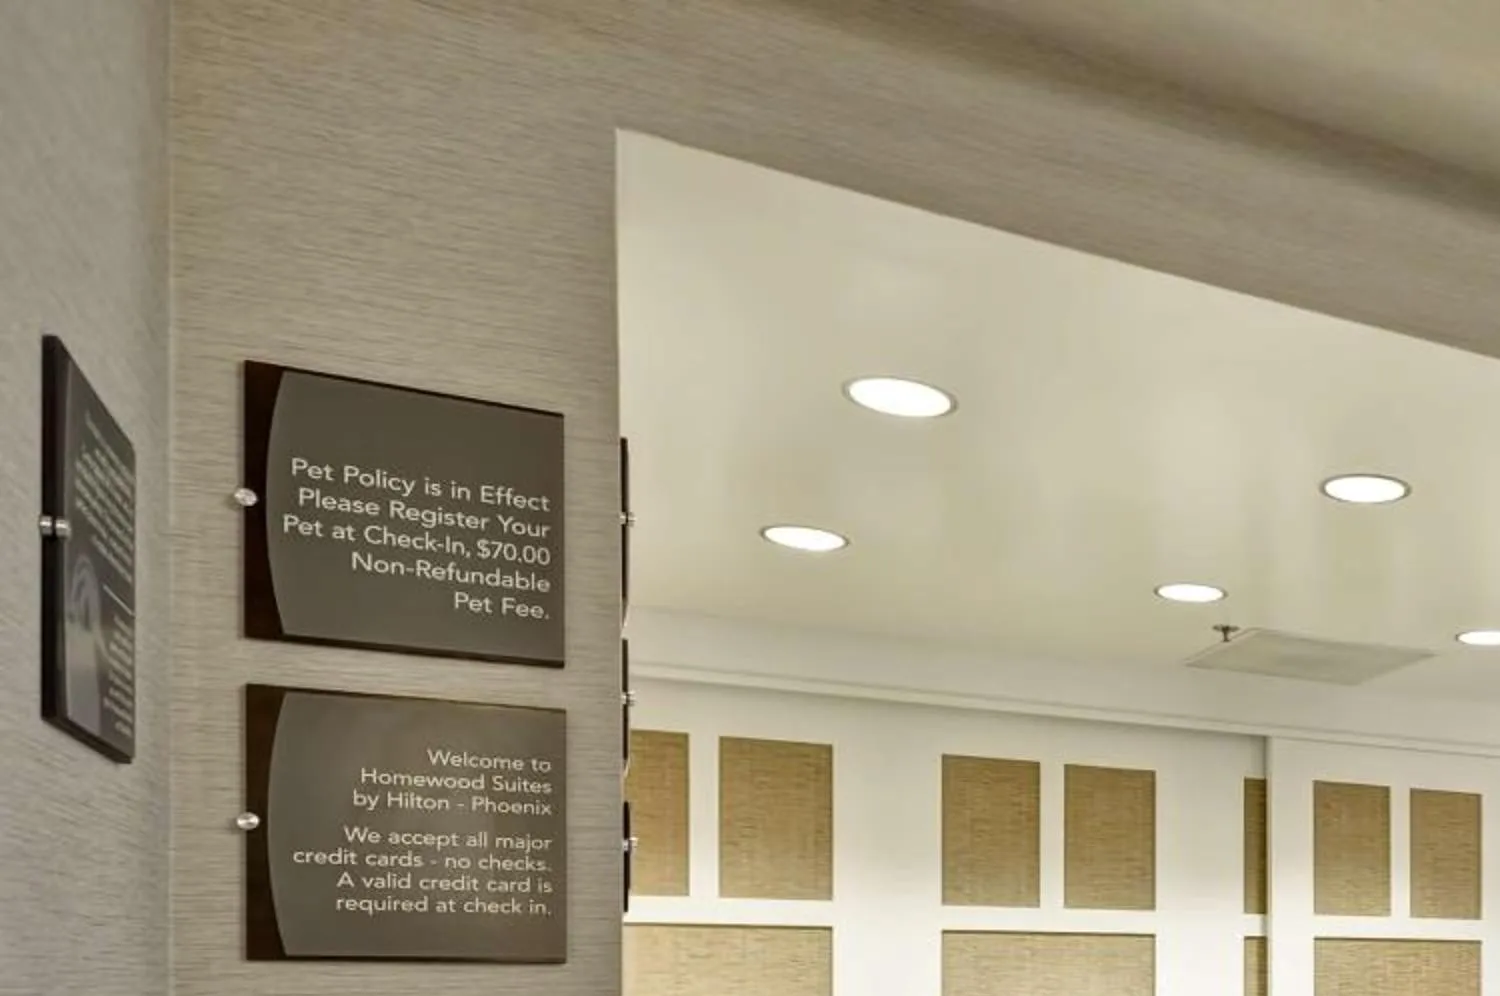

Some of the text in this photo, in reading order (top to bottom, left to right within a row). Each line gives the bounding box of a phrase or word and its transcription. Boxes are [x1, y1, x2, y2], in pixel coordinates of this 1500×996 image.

[291, 457, 550, 512] Pet Policy is in Effect
[299, 487, 551, 538] Please Register Your
[283, 514, 323, 538] Pet
[331, 525, 356, 542] at
[477, 538, 551, 566] $70.00
[351, 551, 550, 593] Non-Refundable
[454, 591, 550, 620] Pet Fee.
[427, 748, 551, 773] Welcome to
[360, 767, 552, 795] Homewood Suites
[353, 788, 379, 811] by
[387, 791, 450, 811] Hilton
[471, 795, 551, 815] Phoenix
[343, 824, 552, 854] We accept all major
[292, 848, 358, 866] credit
[365, 850, 424, 868] cards
[445, 856, 472, 869] no
[336, 871, 553, 893] A valid credit card is
[335, 895, 551, 916] required at check in.
